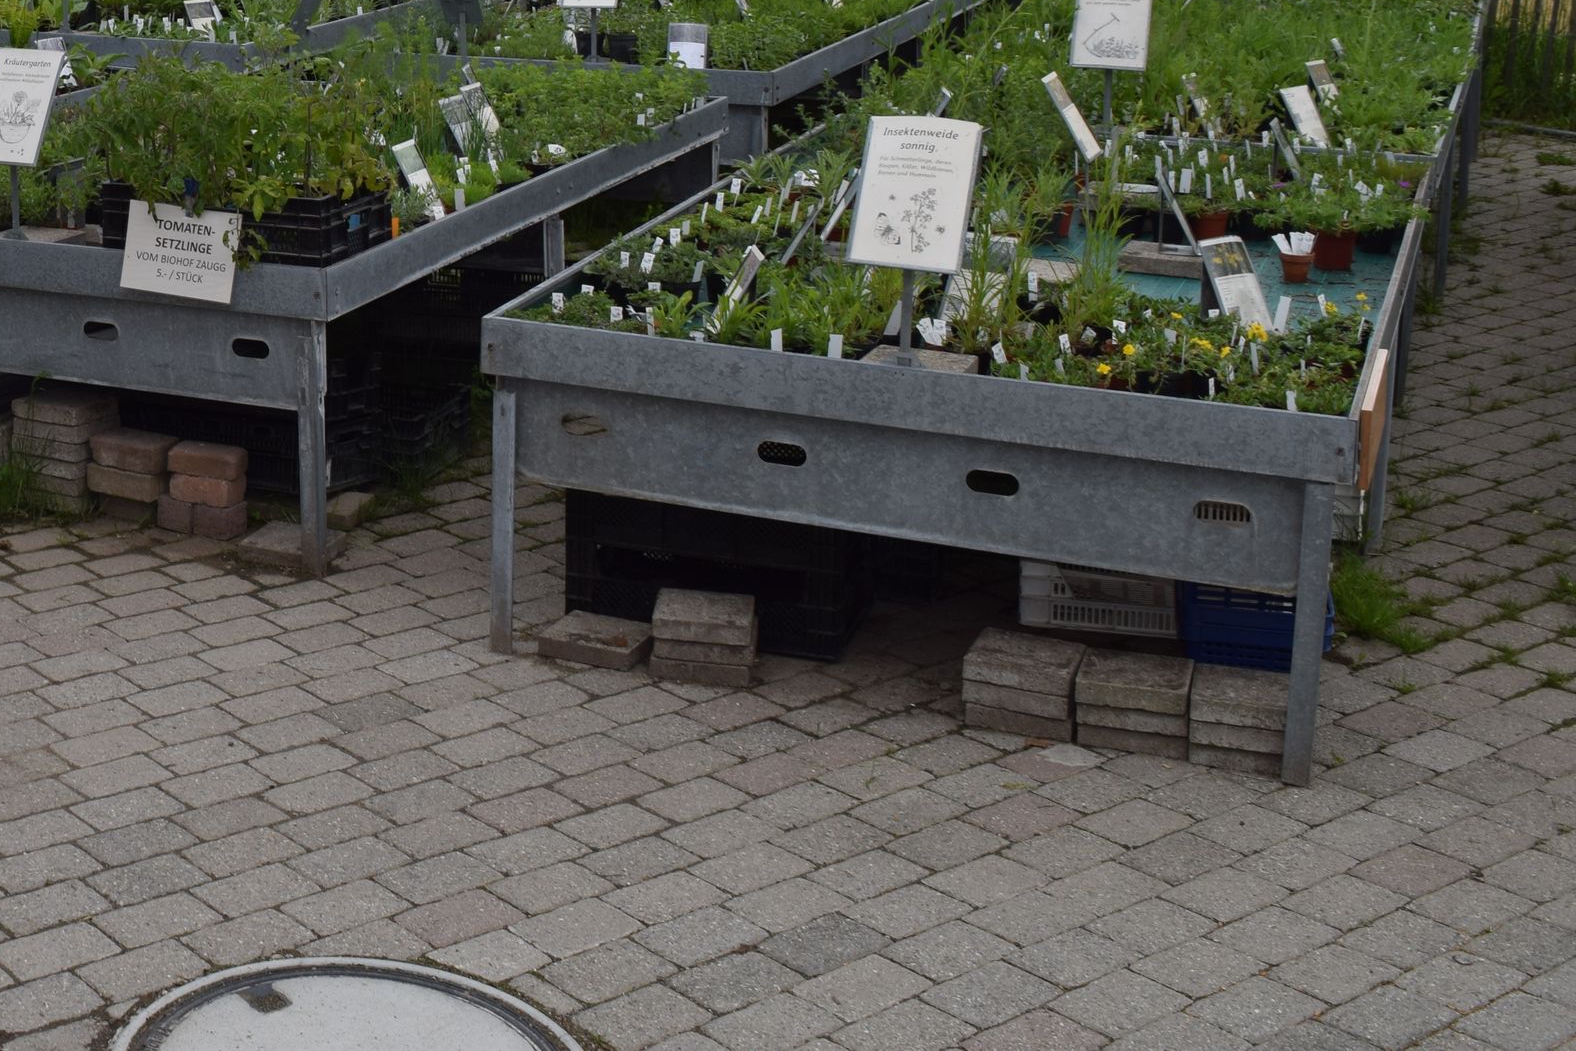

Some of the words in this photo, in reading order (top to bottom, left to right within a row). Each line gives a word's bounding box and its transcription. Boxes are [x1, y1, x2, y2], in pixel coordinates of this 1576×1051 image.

[3, 58, 52, 69] Kräutergarten
[883, 127, 960, 141] Insektenweide
[156, 218, 216, 237] TOMATEN-
[155, 237, 212, 255] SETZLINGE
[136, 250, 158, 262] VOM
[160, 254, 194, 268] BIOHOF
[196, 260, 226, 273] ZAUGG
[176, 271, 204, 284] STÜCK
